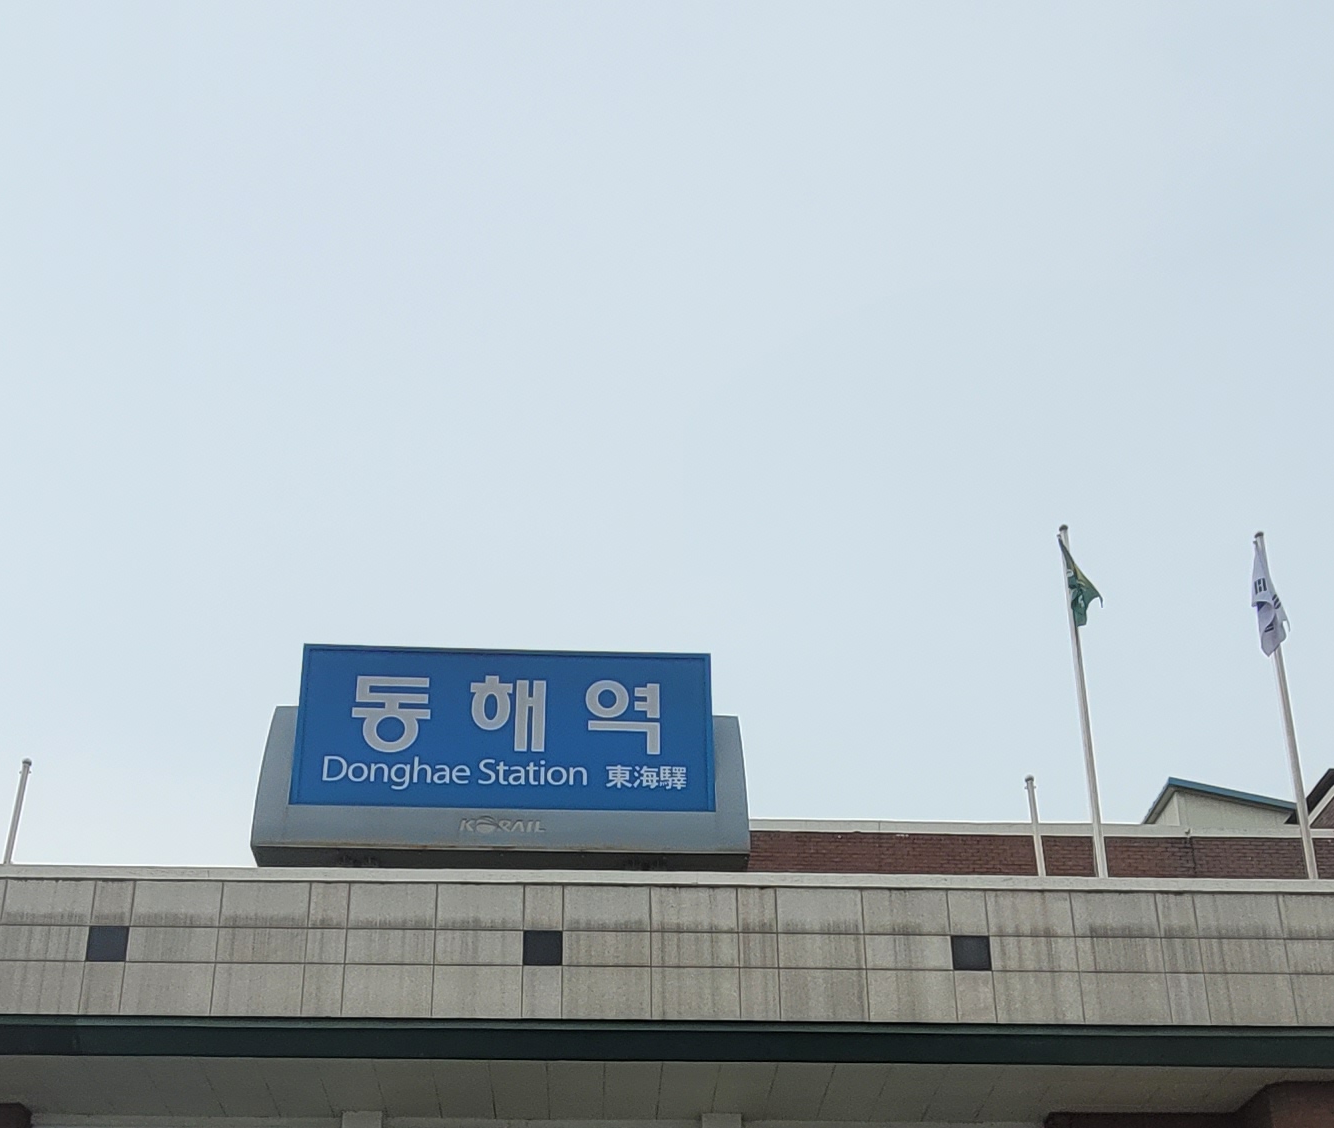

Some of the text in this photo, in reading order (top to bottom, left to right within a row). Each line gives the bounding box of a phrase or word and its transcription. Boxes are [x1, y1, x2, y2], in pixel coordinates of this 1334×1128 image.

[351, 675, 661, 755] 동해역
[321, 755, 588, 790] Donghae Station
[605, 765, 688, 790] 東海驛
